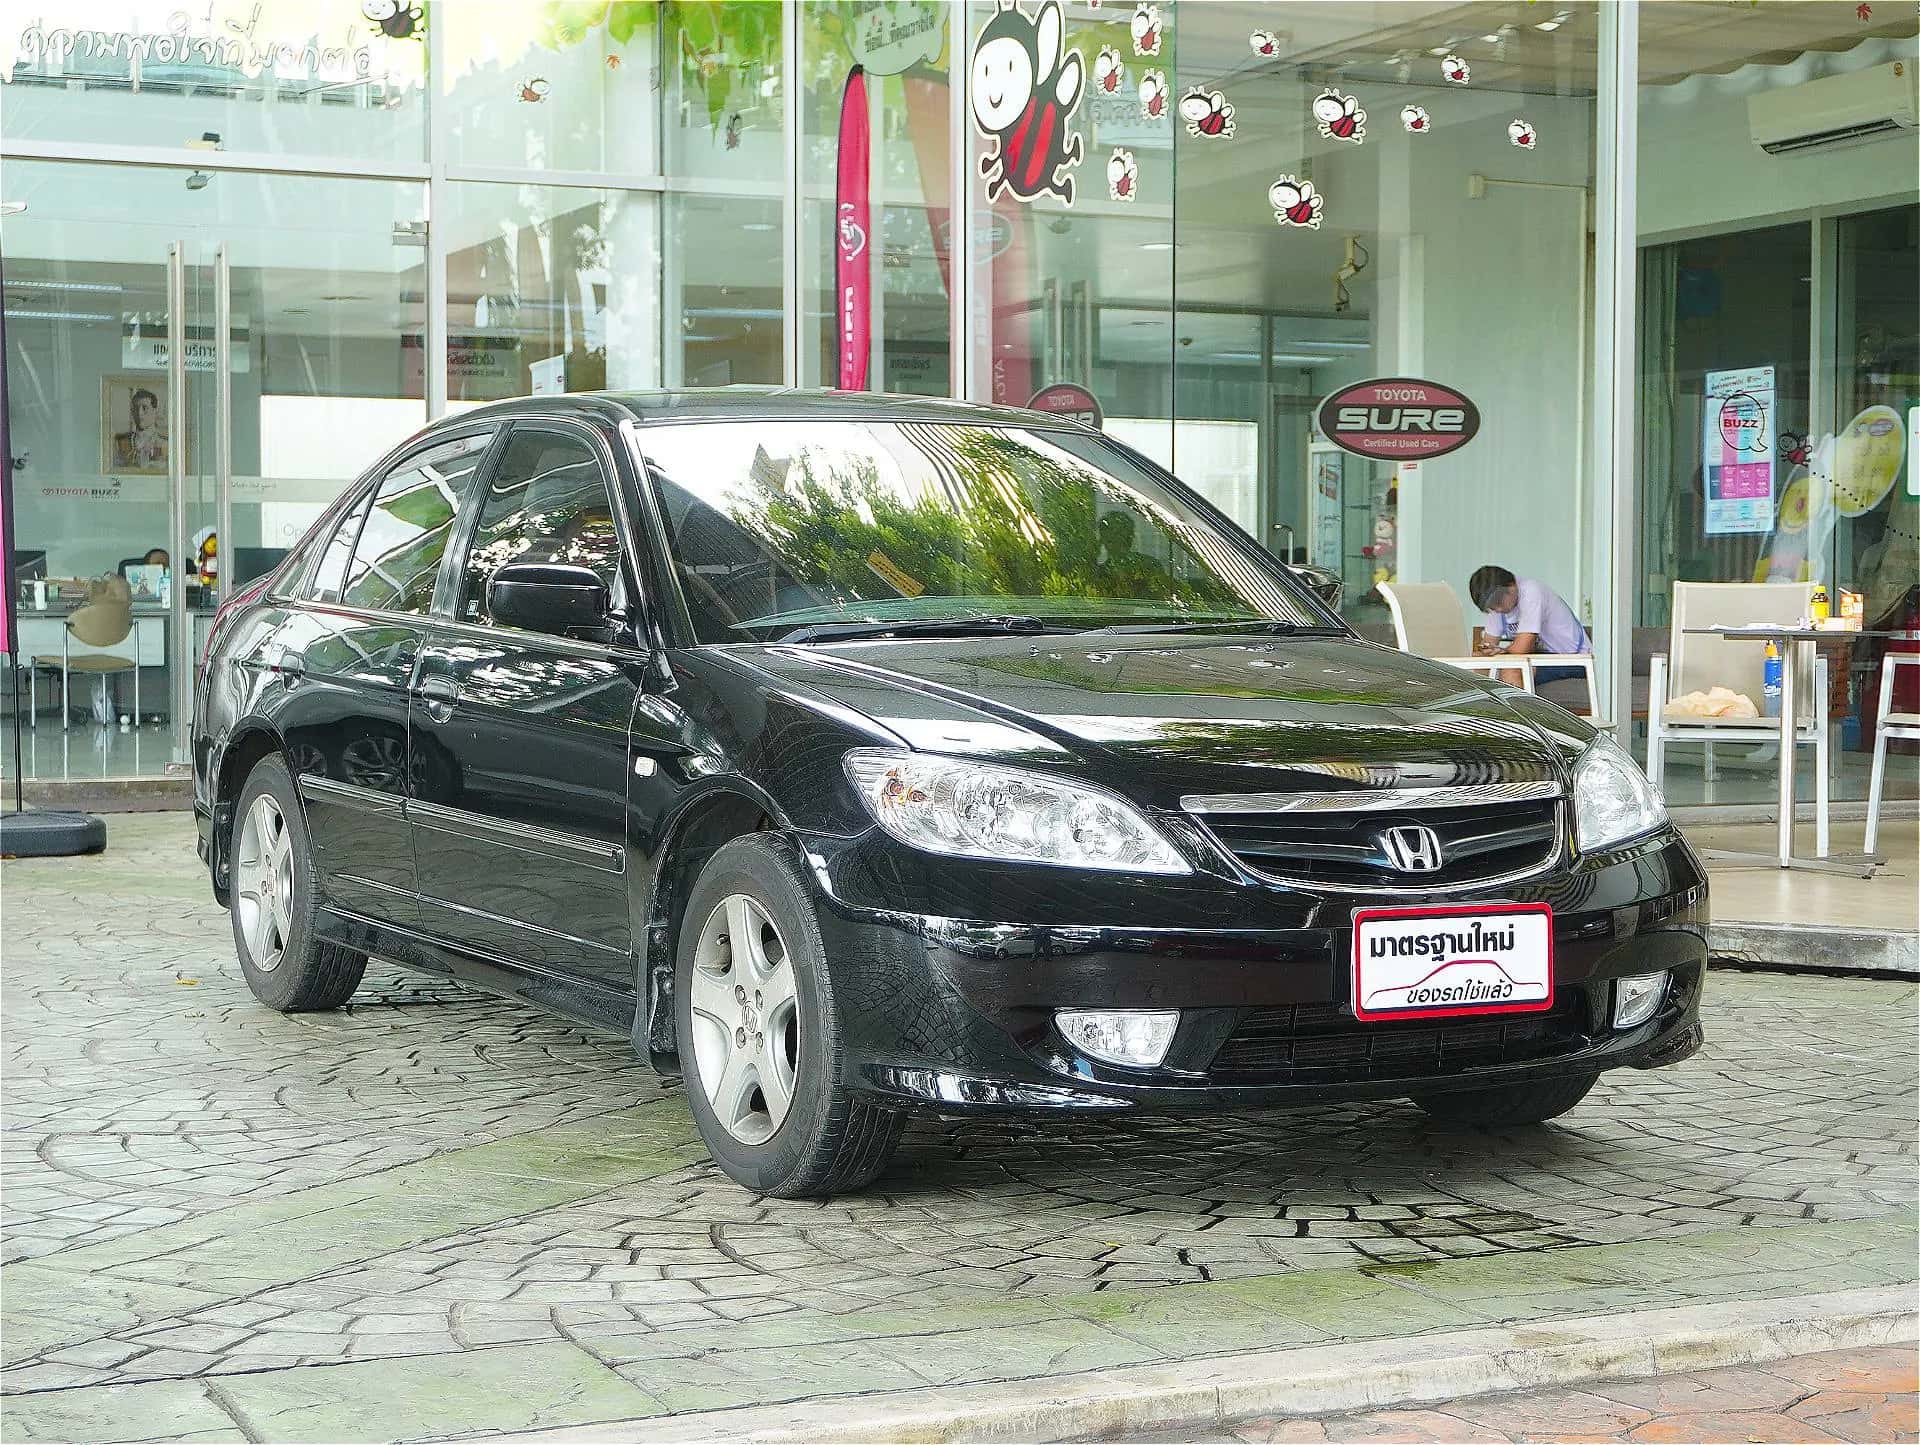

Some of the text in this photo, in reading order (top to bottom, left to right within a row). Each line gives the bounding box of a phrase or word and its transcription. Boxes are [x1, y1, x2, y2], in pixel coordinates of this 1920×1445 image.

[1375, 388, 1427, 401] TOYOTA
[1723, 418, 1759, 428] BUZZ
[1364, 438, 1440, 448] Certified Used Cars
[1370, 921, 1515, 962] มาตรฐานใหม่
[1407, 978, 1513, 1004] ของรถใช้แล้ว
